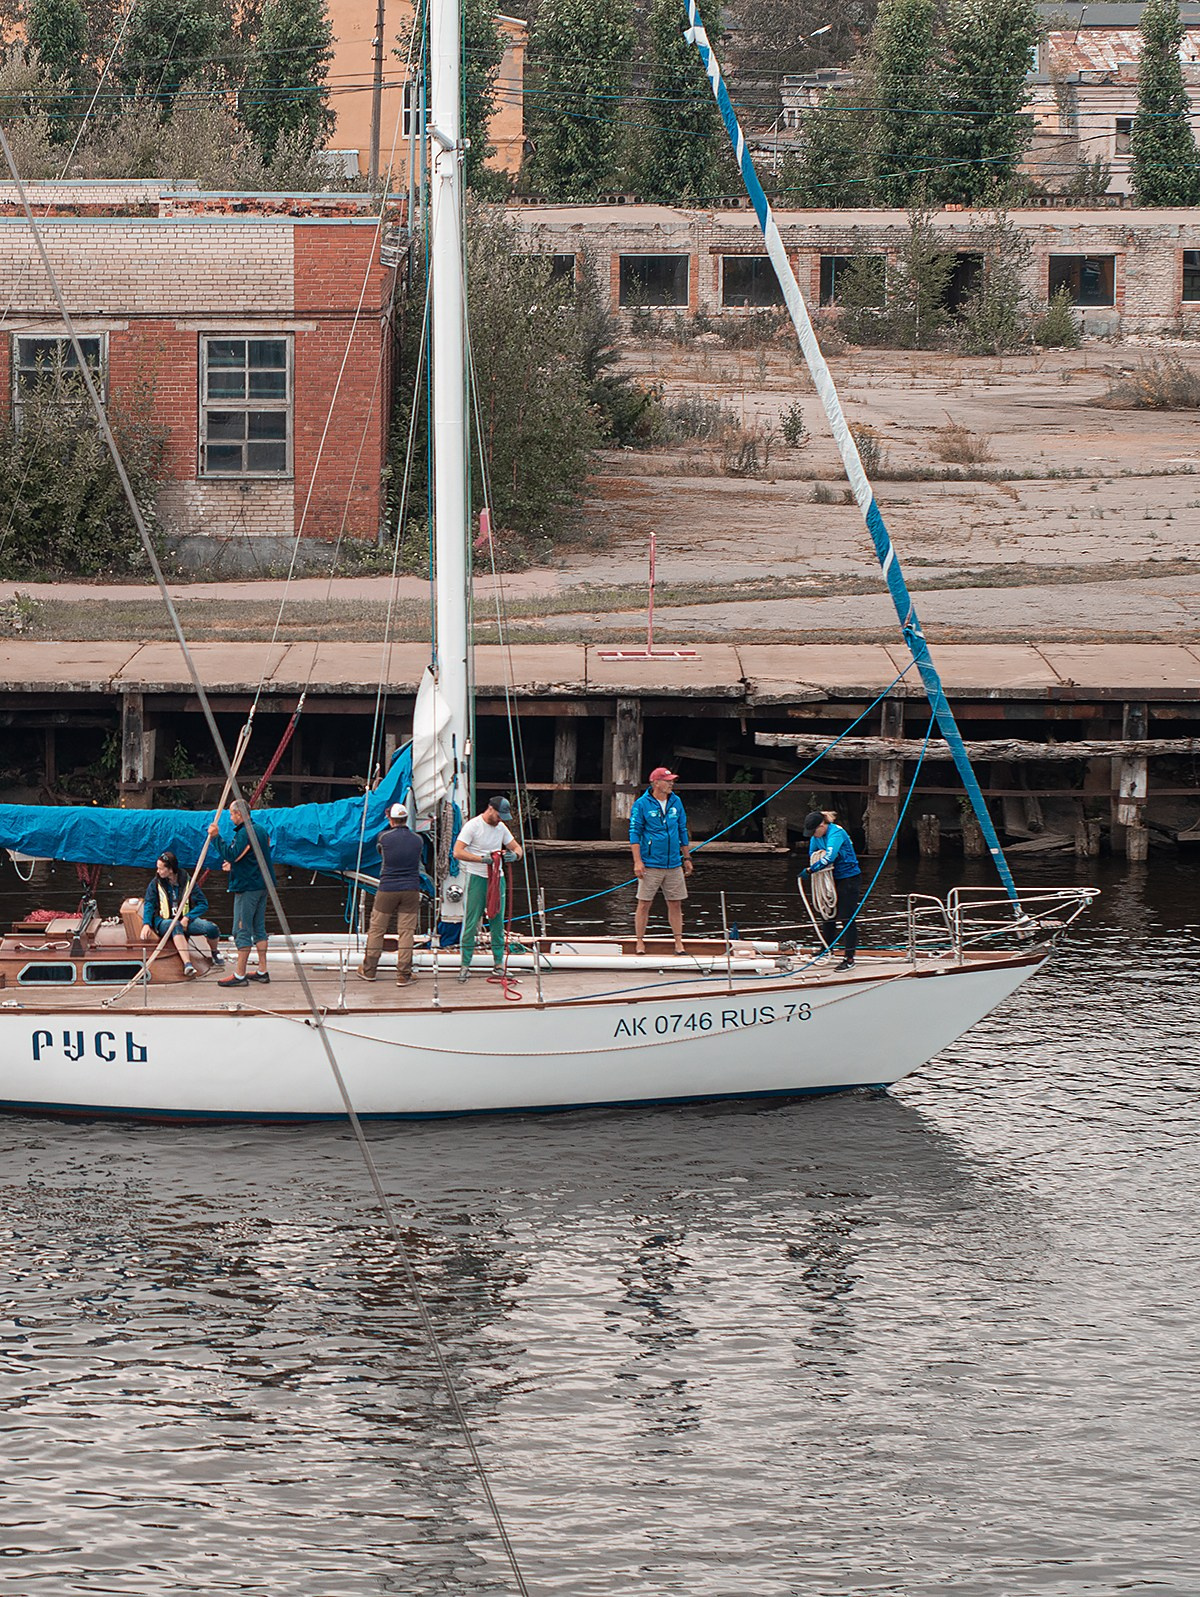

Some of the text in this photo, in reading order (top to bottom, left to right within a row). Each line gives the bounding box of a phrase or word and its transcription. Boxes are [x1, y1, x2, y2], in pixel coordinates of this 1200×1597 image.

[654, 1012, 713, 1035] 0746
[721, 1006, 776, 1029] RUS
[784, 1002, 812, 1023] 78
[32, 1030, 148, 1062] РУСЬ
